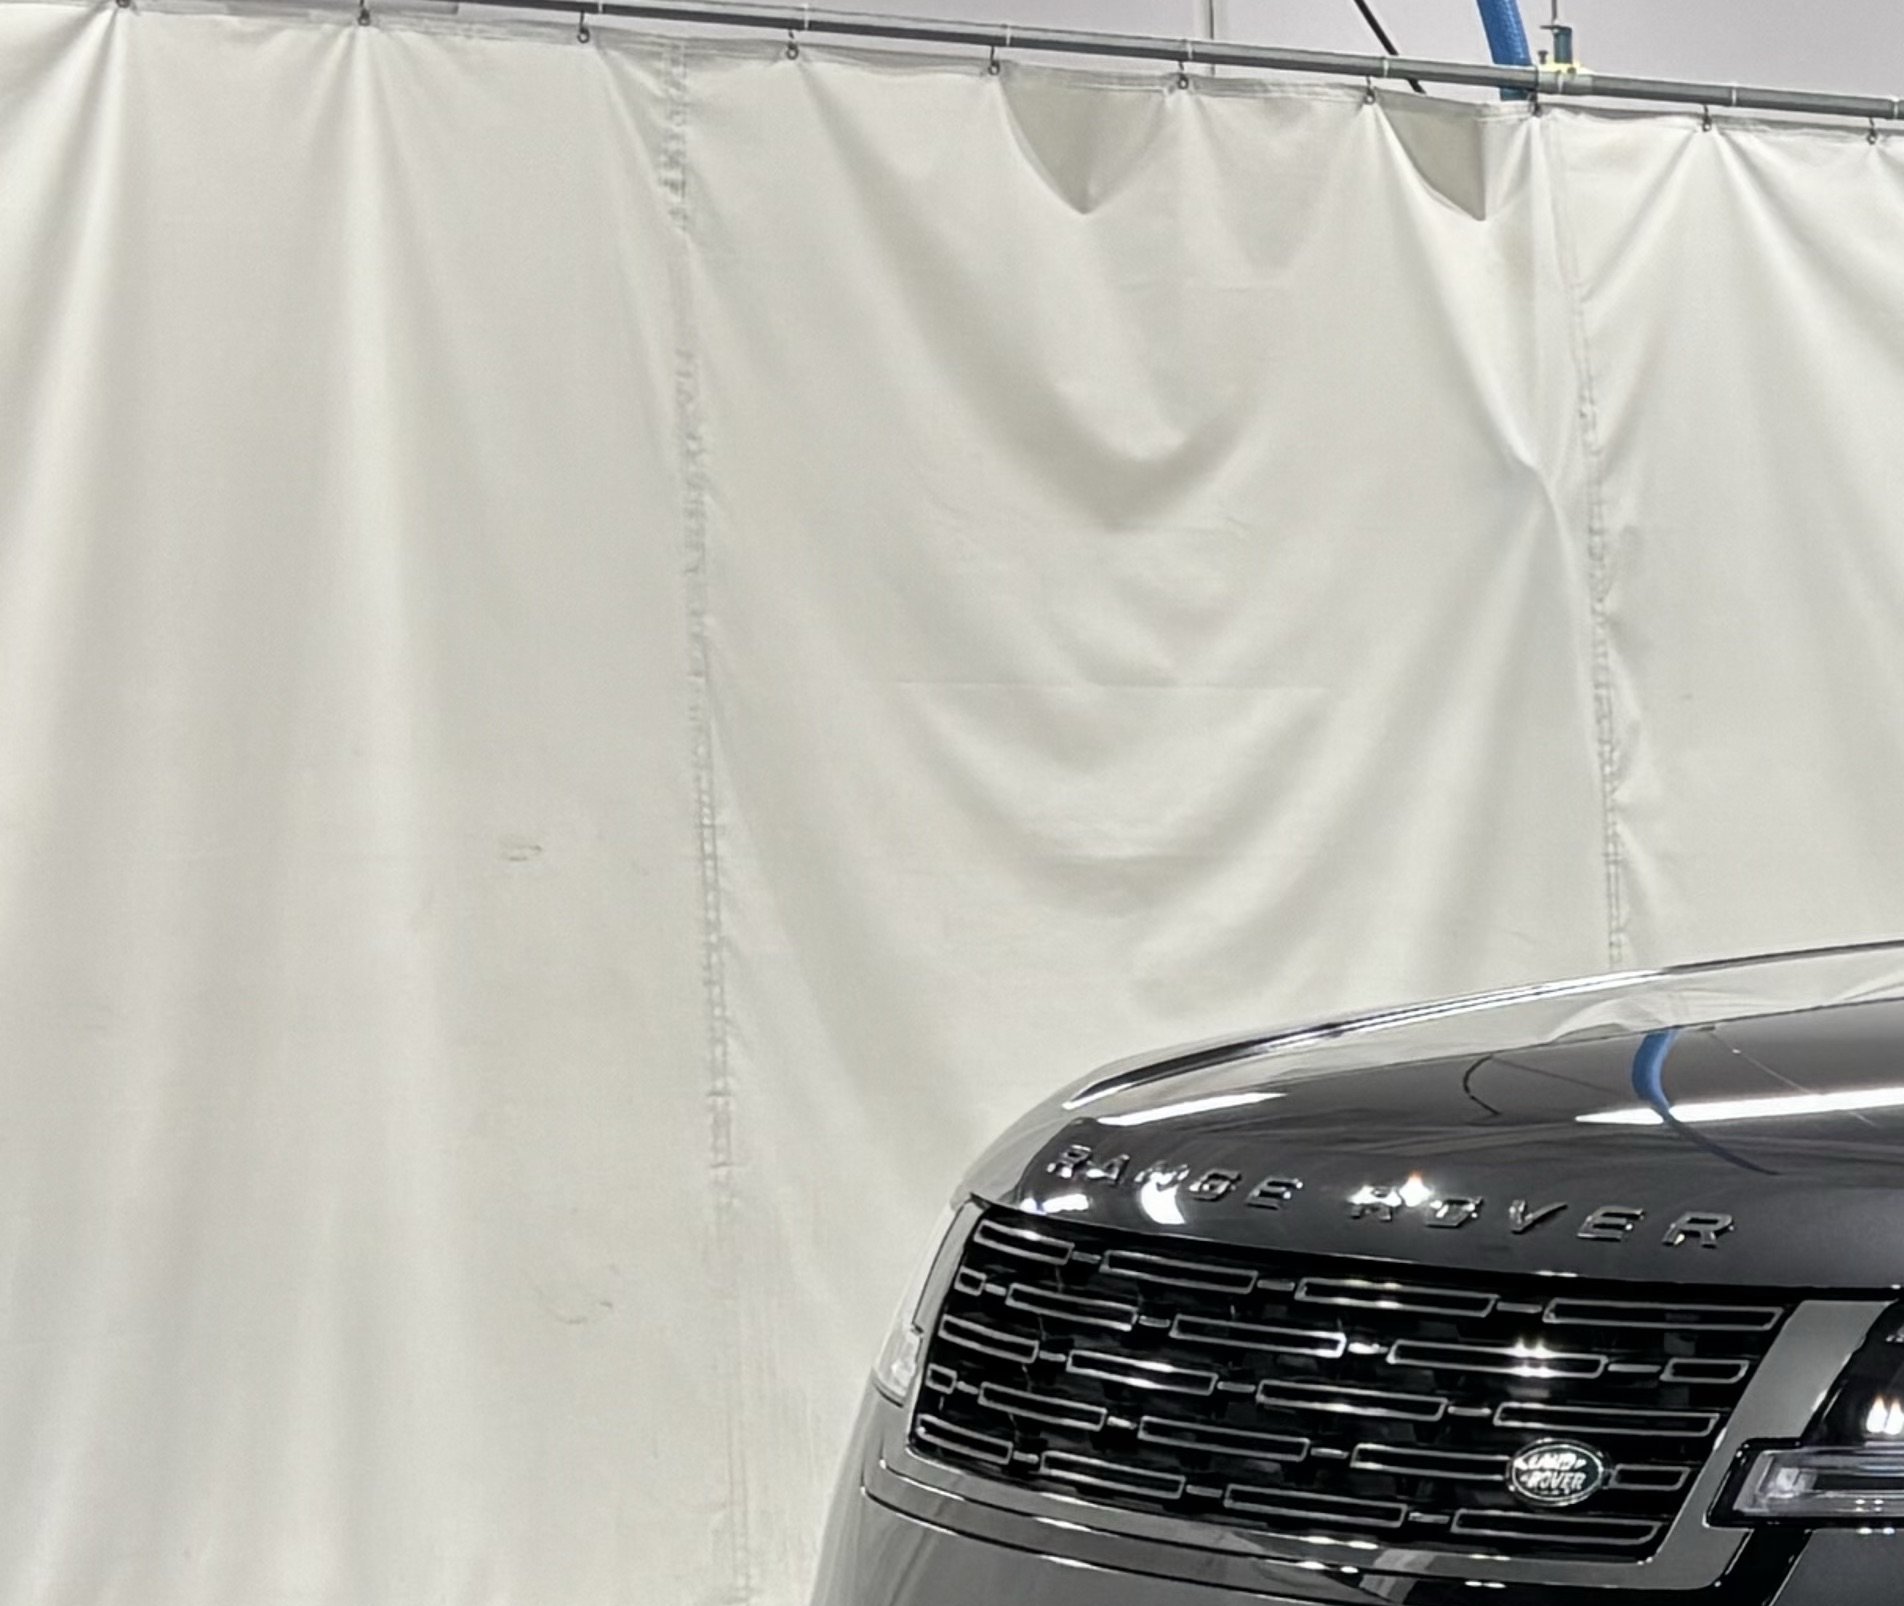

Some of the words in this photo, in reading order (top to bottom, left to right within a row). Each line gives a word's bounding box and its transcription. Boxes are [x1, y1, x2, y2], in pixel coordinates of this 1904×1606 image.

[1047, 1144, 1303, 1211] RANGE
[1349, 1185, 1735, 1248] ROVER
[1527, 1452, 1577, 1471] LAND
[1526, 1470, 1587, 1490] ROVER
